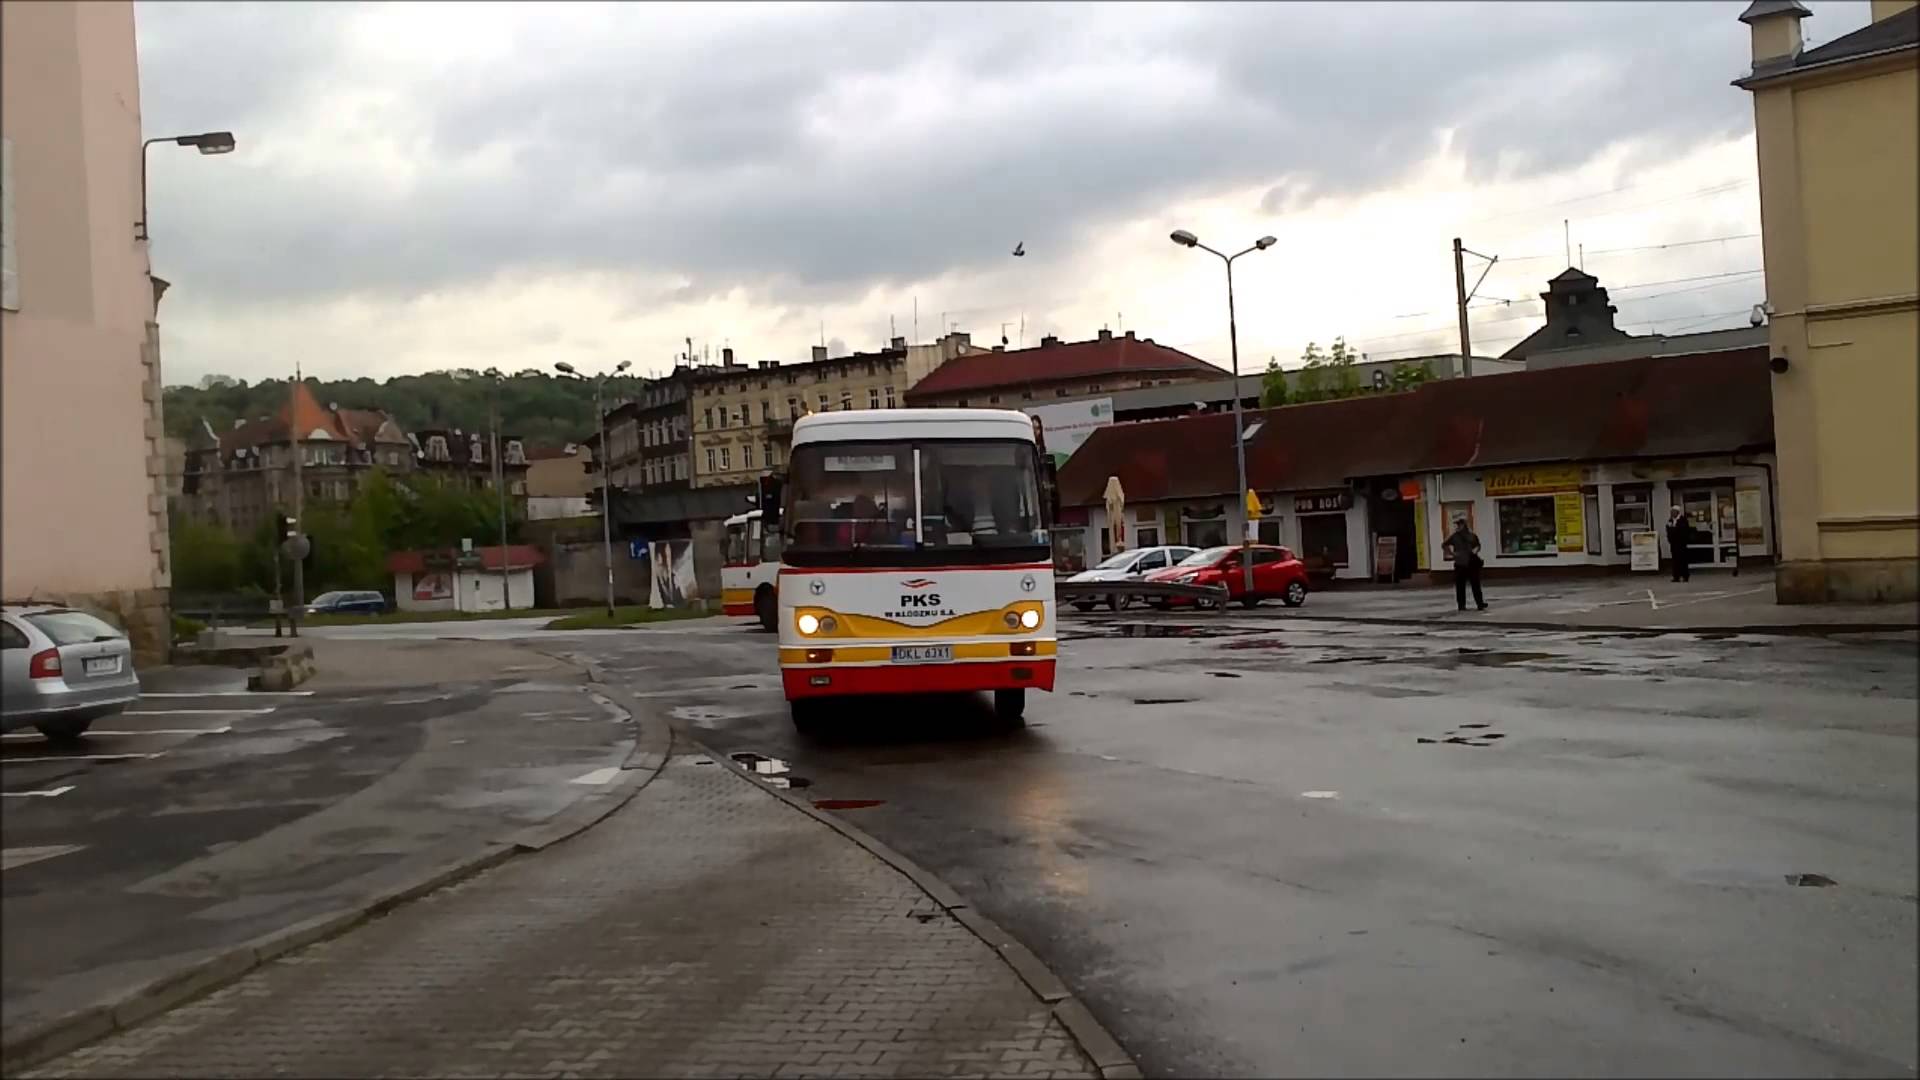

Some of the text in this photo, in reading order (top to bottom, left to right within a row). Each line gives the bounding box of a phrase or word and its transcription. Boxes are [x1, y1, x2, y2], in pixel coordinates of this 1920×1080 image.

[1488, 472, 1536, 488] Tabak
[901, 594, 941, 607] PKS
[899, 648, 921, 660] DKL
